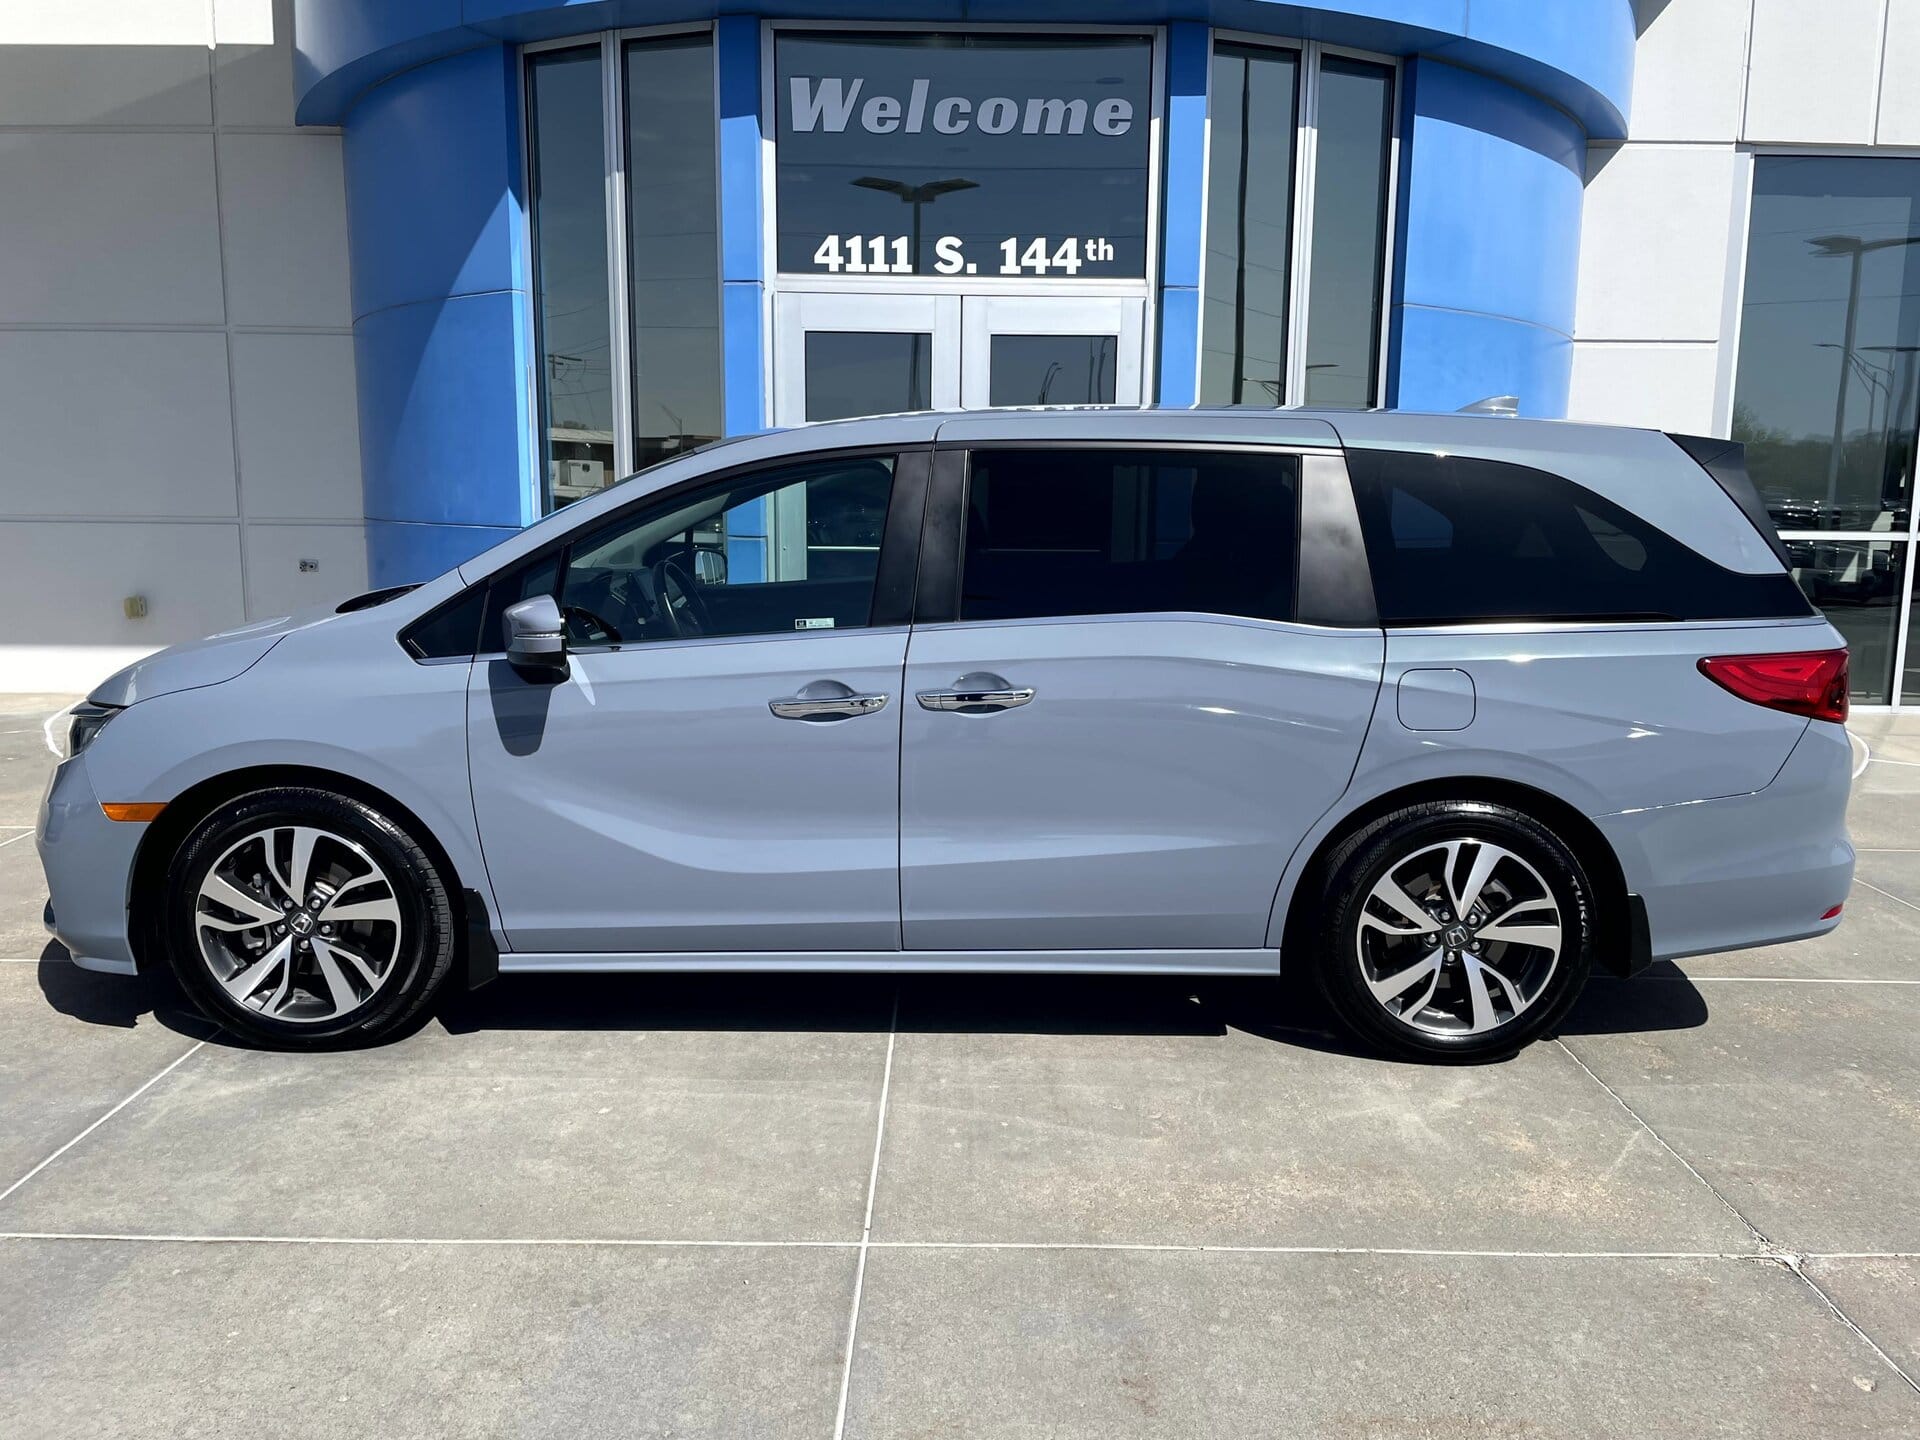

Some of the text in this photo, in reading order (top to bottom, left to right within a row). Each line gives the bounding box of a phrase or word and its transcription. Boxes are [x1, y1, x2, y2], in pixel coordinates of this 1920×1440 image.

[789, 77, 1134, 136] Welcome
[813, 234, 1115, 275] 4111 S. 144th
